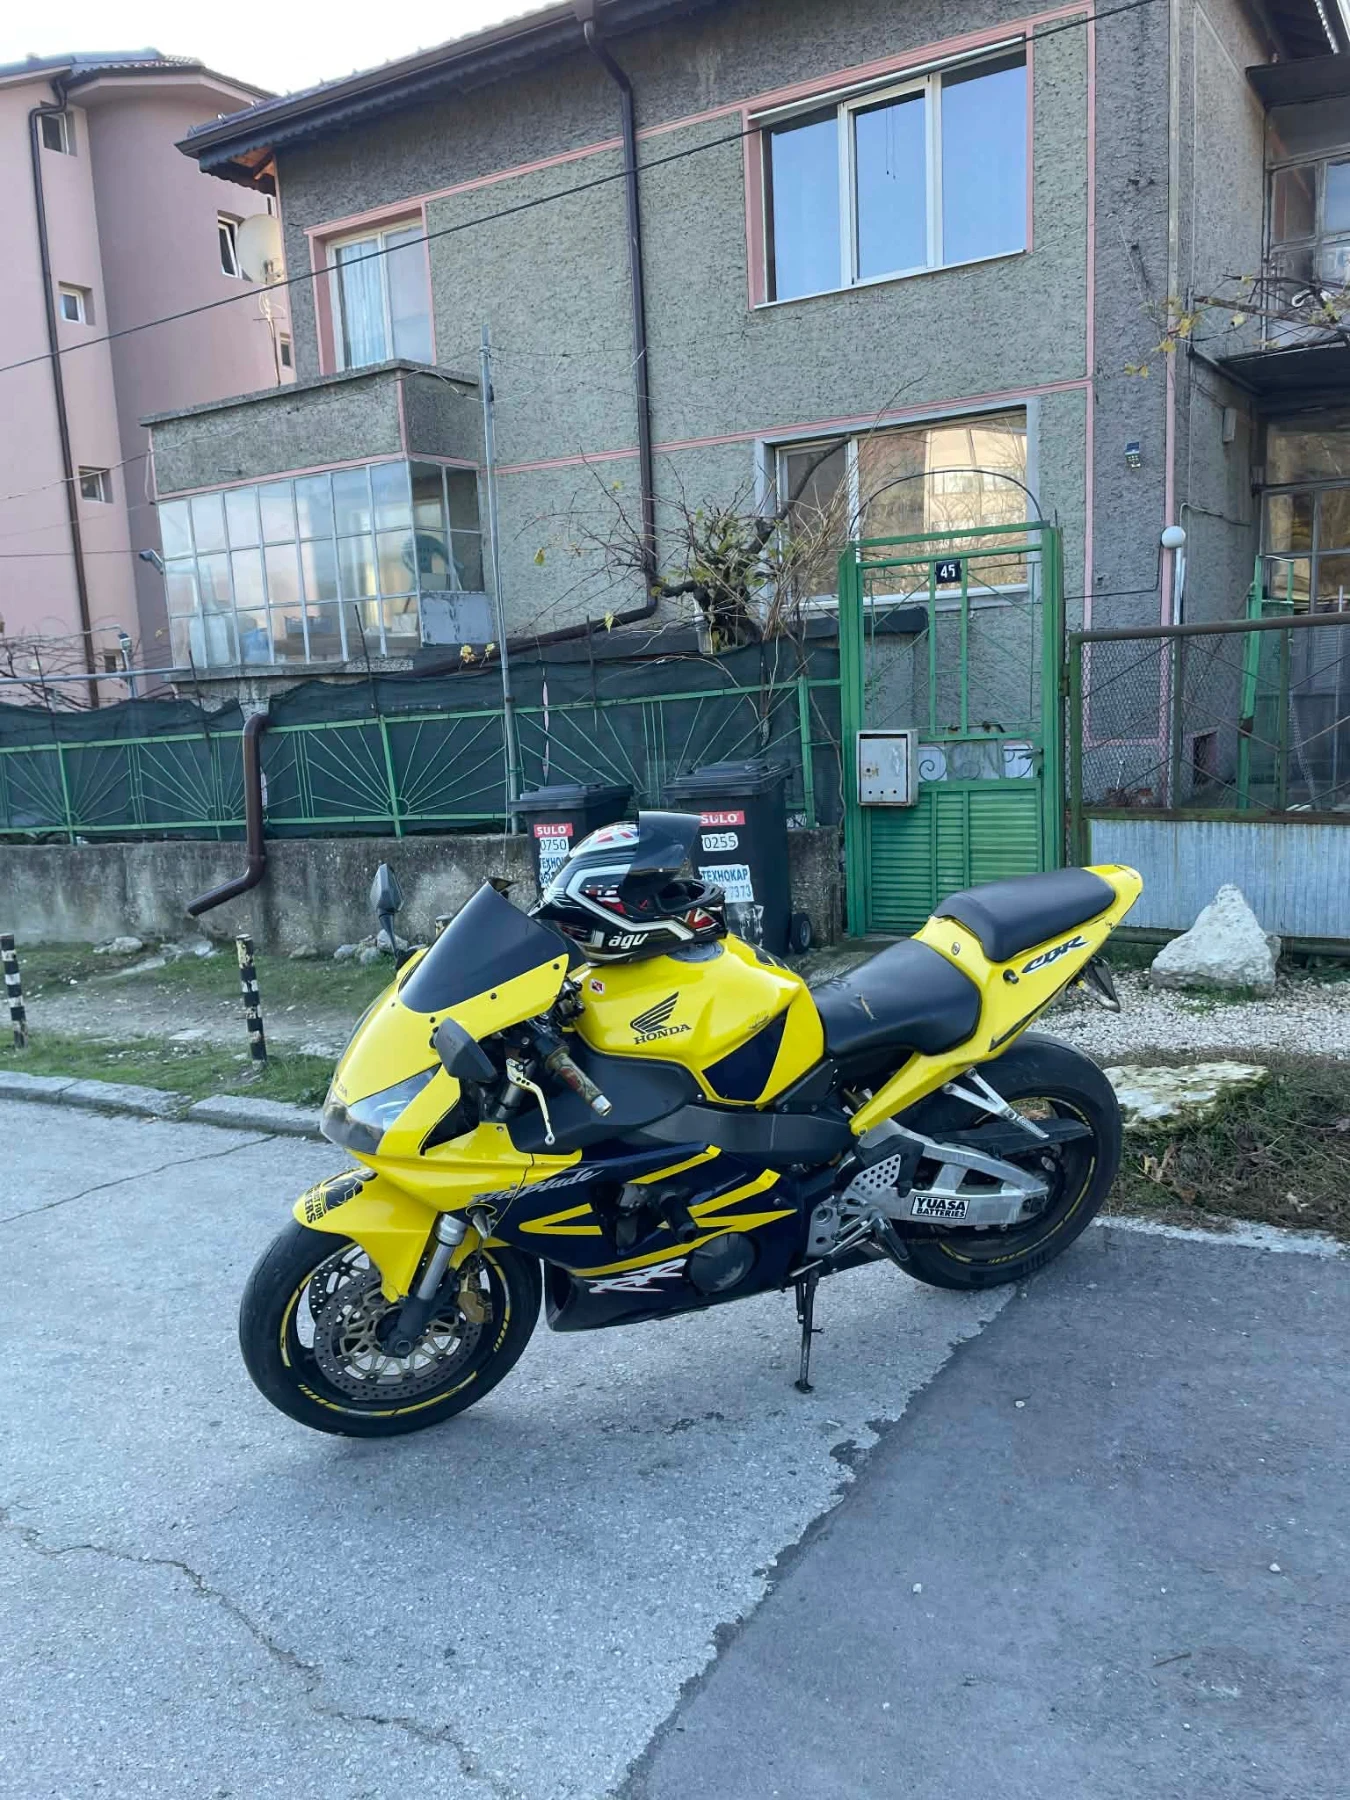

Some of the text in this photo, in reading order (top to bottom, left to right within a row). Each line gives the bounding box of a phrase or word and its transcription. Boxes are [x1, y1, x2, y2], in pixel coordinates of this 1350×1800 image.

[940, 564, 956, 579] 45
[701, 813, 738, 825] SULO
[536, 825, 567, 835] SULO
[540, 839, 567, 851] 0750
[703, 835, 737, 849] 0255
[701, 868, 748, 882] ТЕХНОКАР
[608, 931, 649, 949] agv
[1021, 935, 1089, 974] CBR
[633, 1023, 692, 1045] HONDA
[917, 1197, 966, 1211] YUASA
[916, 1207, 966, 1217] BATTERIES
